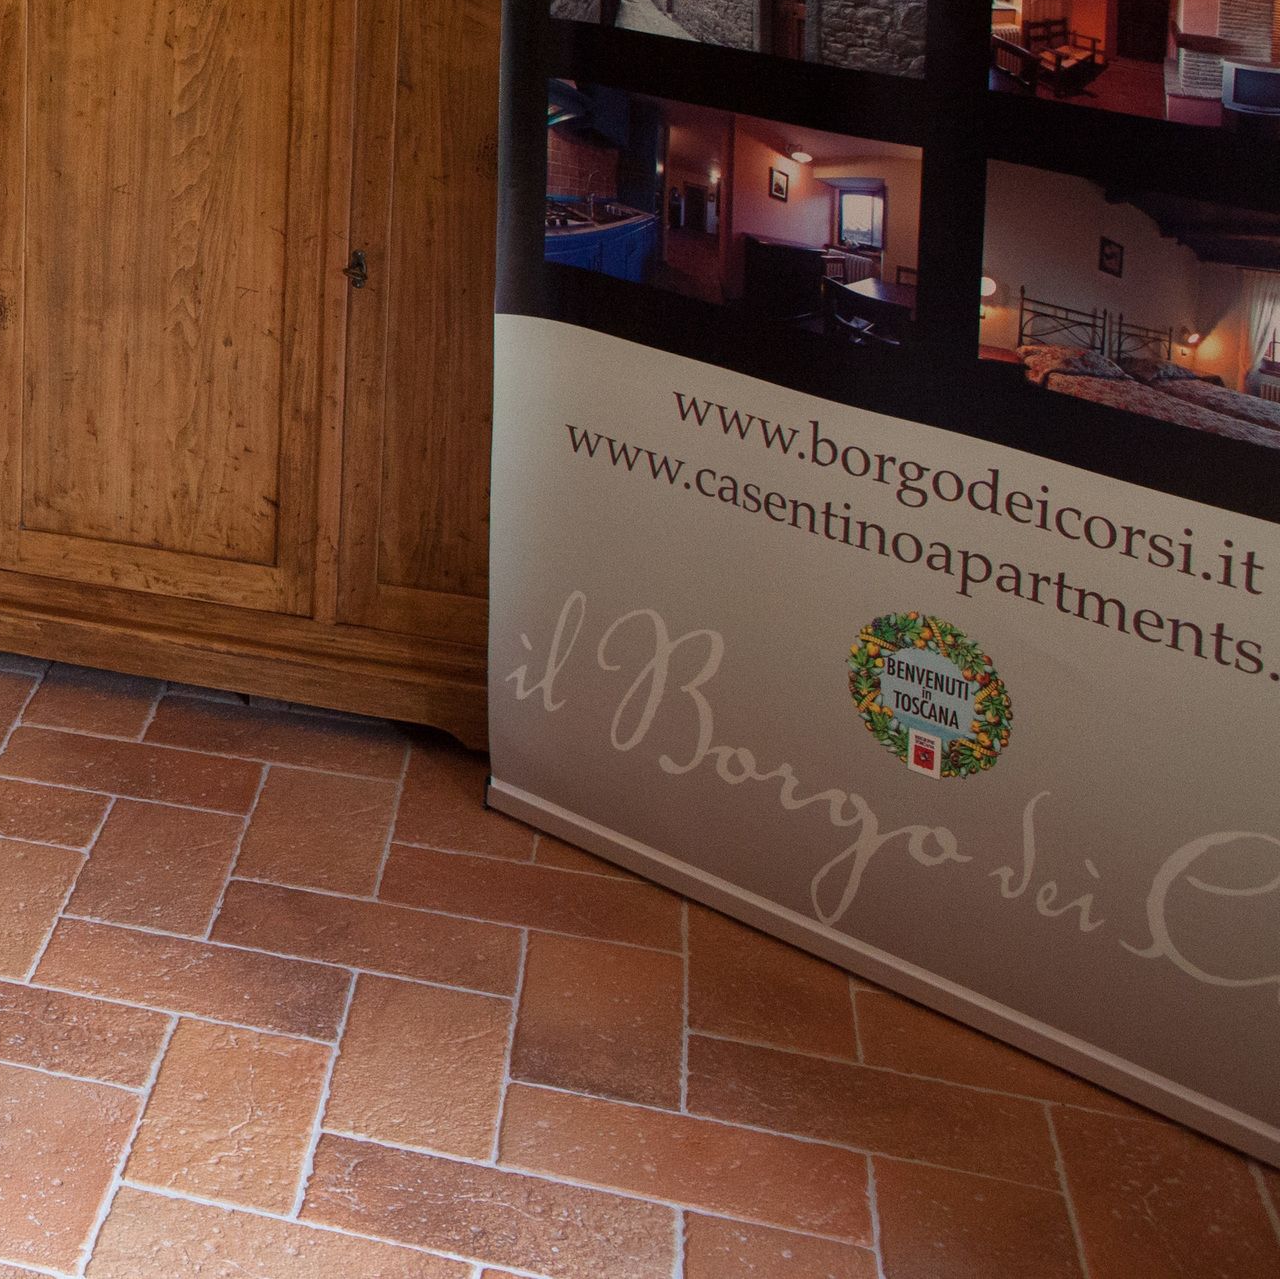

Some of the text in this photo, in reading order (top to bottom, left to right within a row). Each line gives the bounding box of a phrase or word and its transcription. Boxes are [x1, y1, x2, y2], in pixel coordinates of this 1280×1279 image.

[672, 390, 1265, 596] www.borgodeicorsi.it
[886, 656, 969, 701] BENVENUTI
[921, 686, 932, 701] in
[893, 689, 960, 730] TOSCANA
[505, 589, 587, 712] il
[596, 607, 974, 927] Borgo
